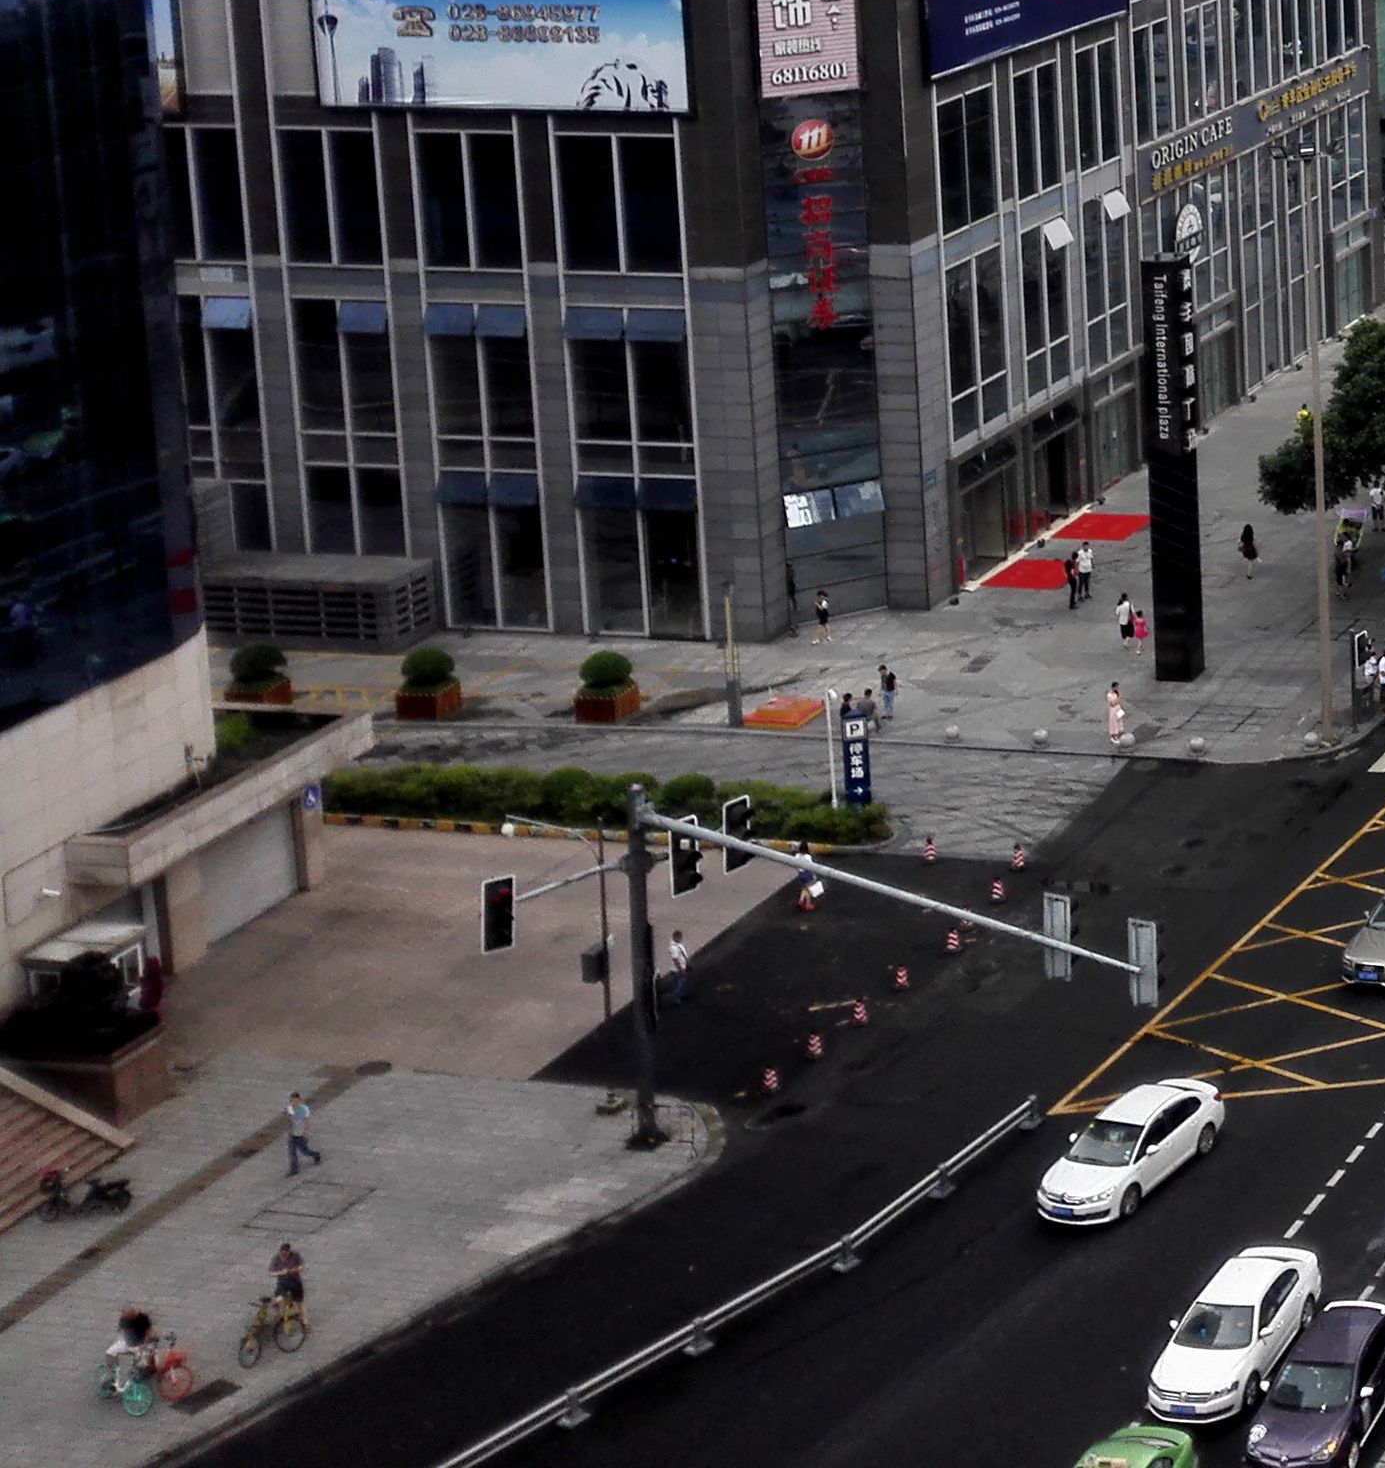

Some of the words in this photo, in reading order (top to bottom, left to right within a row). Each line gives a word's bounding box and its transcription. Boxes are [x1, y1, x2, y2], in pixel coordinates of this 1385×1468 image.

[771, 61, 849, 86] 68116801
[1152, 131, 1198, 170] ORIGIN
[1201, 116, 1233, 146] CAFE
[1152, 274, 1167, 320] Taifeng
[1154, 322, 1170, 405] International
[1158, 406, 1169, 440] plaza
[850, 724, 859, 735] P
